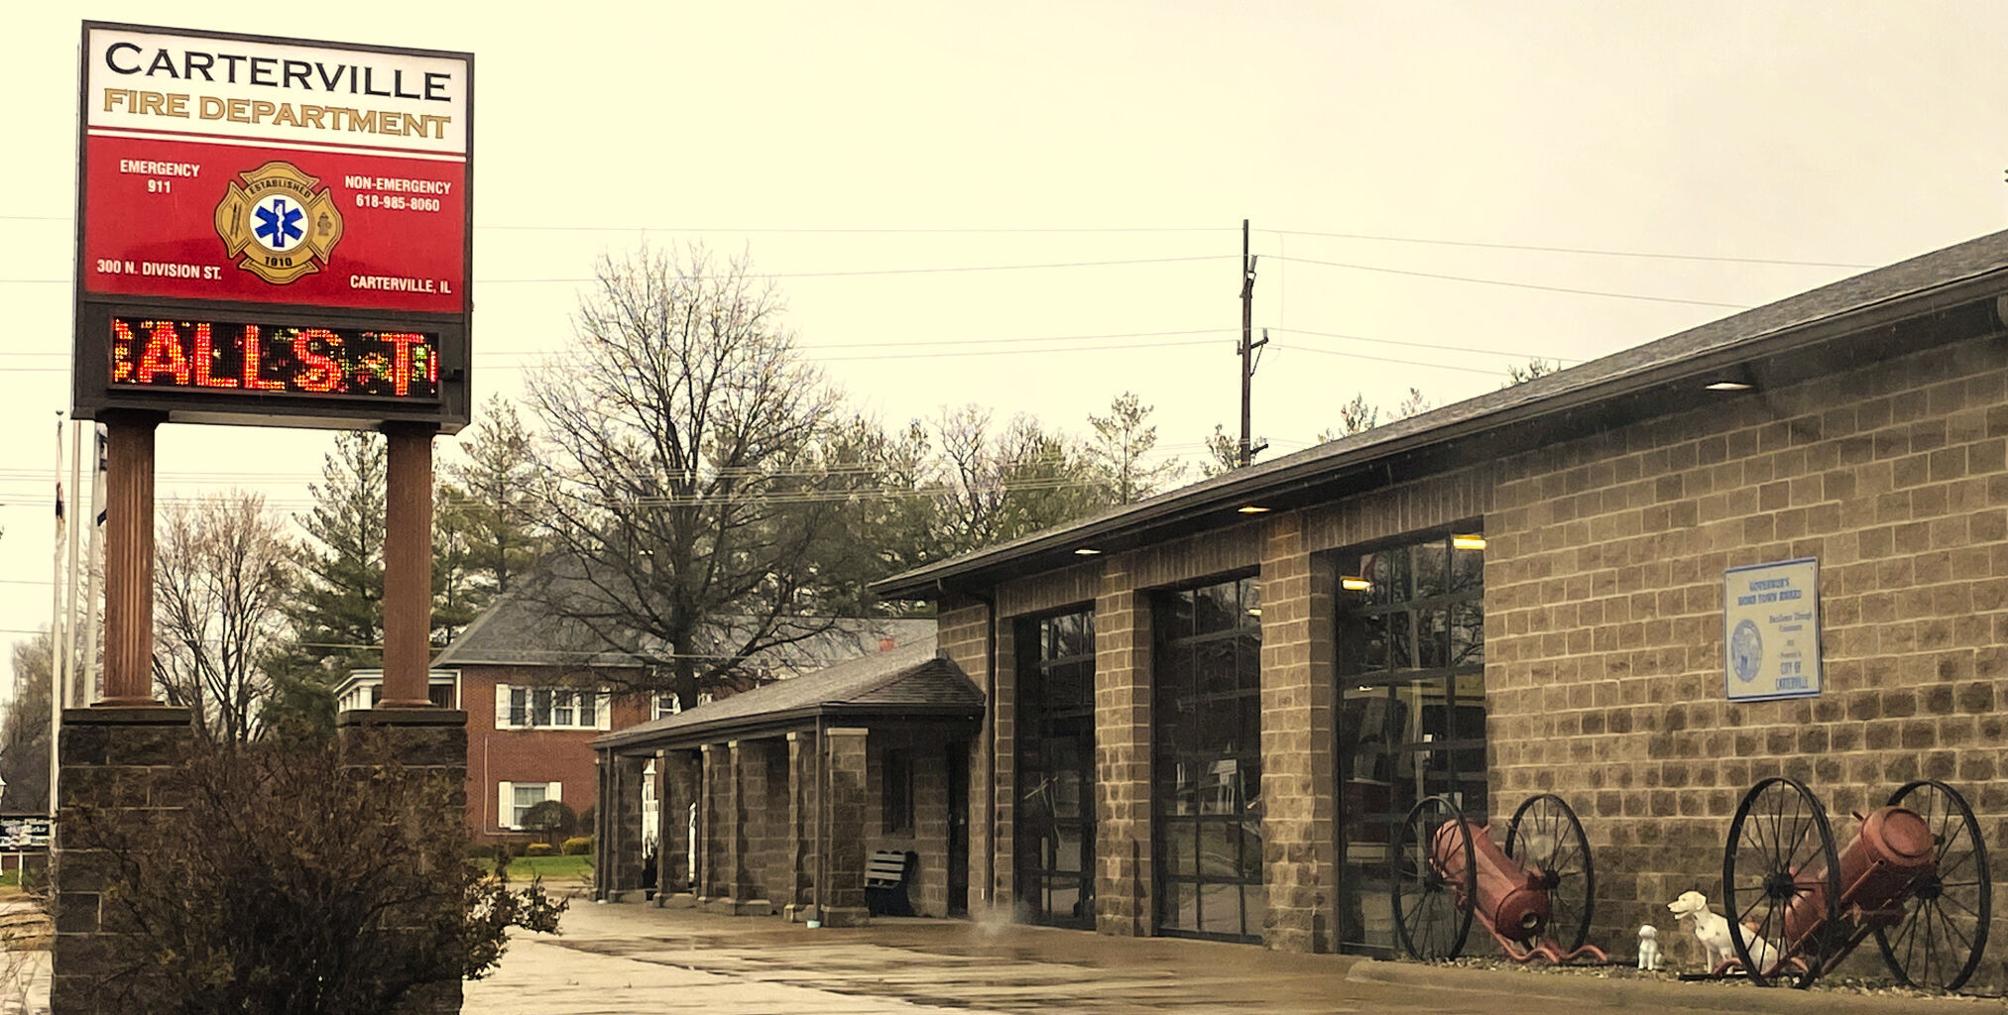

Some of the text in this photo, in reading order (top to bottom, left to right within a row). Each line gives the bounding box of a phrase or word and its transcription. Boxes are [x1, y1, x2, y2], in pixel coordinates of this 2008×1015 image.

[105, 42, 451, 102] CARTERVILLE
[103, 87, 451, 139] FIRE DEPARTMENT
[120, 159, 200, 177] EMERGENCY
[147, 178, 171, 193] 911
[249, 179, 311, 198] ESTABLISHED
[345, 175, 451, 195] NON-EMERGENCY
[356, 194, 440, 212] 618-985-8060
[97, 260, 222, 280] 300 N. DIVISION ST.
[350, 275, 451, 294] CARTERVILLE, IL
